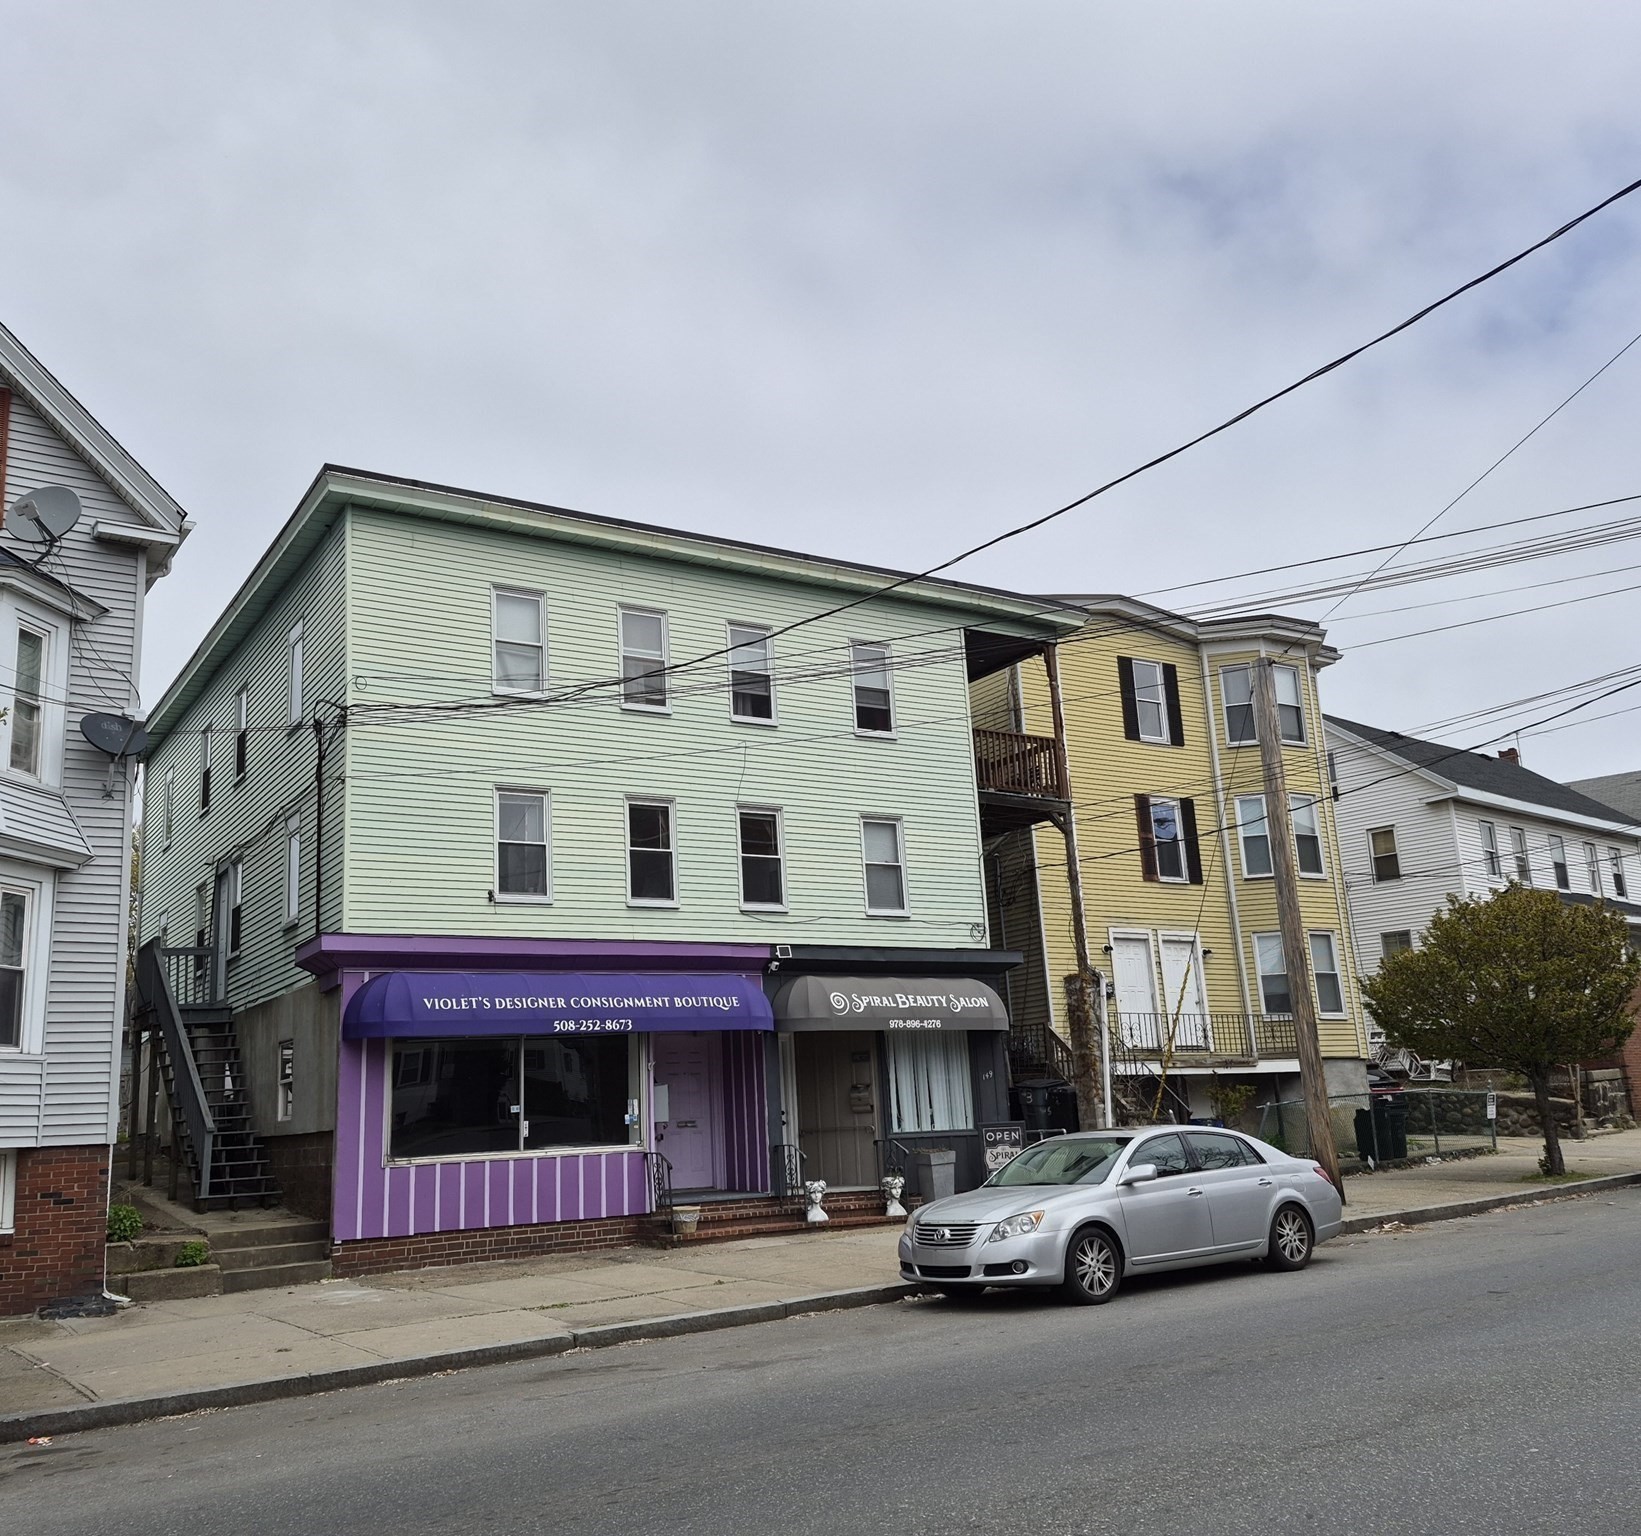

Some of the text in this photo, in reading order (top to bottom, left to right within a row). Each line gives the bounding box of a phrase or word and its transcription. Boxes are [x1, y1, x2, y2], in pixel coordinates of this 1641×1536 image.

[101, 721, 122, 732] dish
[423, 996, 740, 1011] VIOLET'S DESIGNER CONSIGNMENT BOUTIQUE
[851, 993, 989, 1013] SPIRAL BEAUTY SALON
[553, 1019, 633, 1033] 508-252-8673
[889, 1019, 942, 1029] 978-896-4276
[982, 1070, 993, 1081] 149
[986, 1131, 1020, 1142] OPEN
